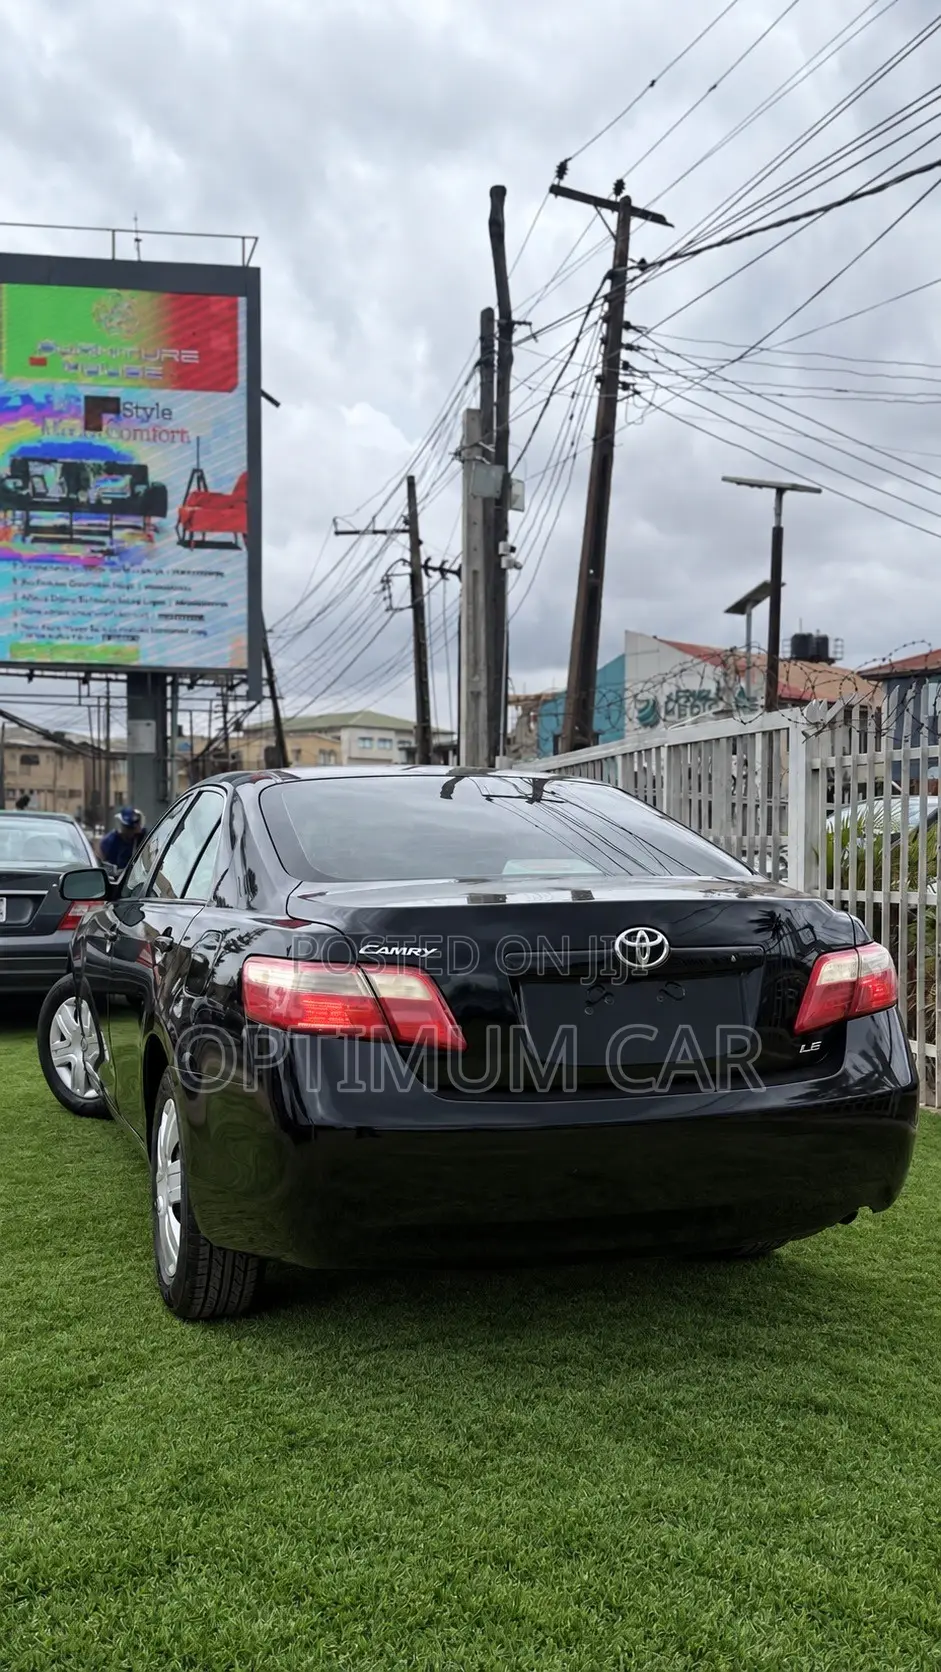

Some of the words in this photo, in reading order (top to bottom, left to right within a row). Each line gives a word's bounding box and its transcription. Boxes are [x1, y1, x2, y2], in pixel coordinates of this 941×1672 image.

[122, 401, 173, 421] Style
[358, 944, 438, 958] CAMRY
[799, 1041, 822, 1054] LE
